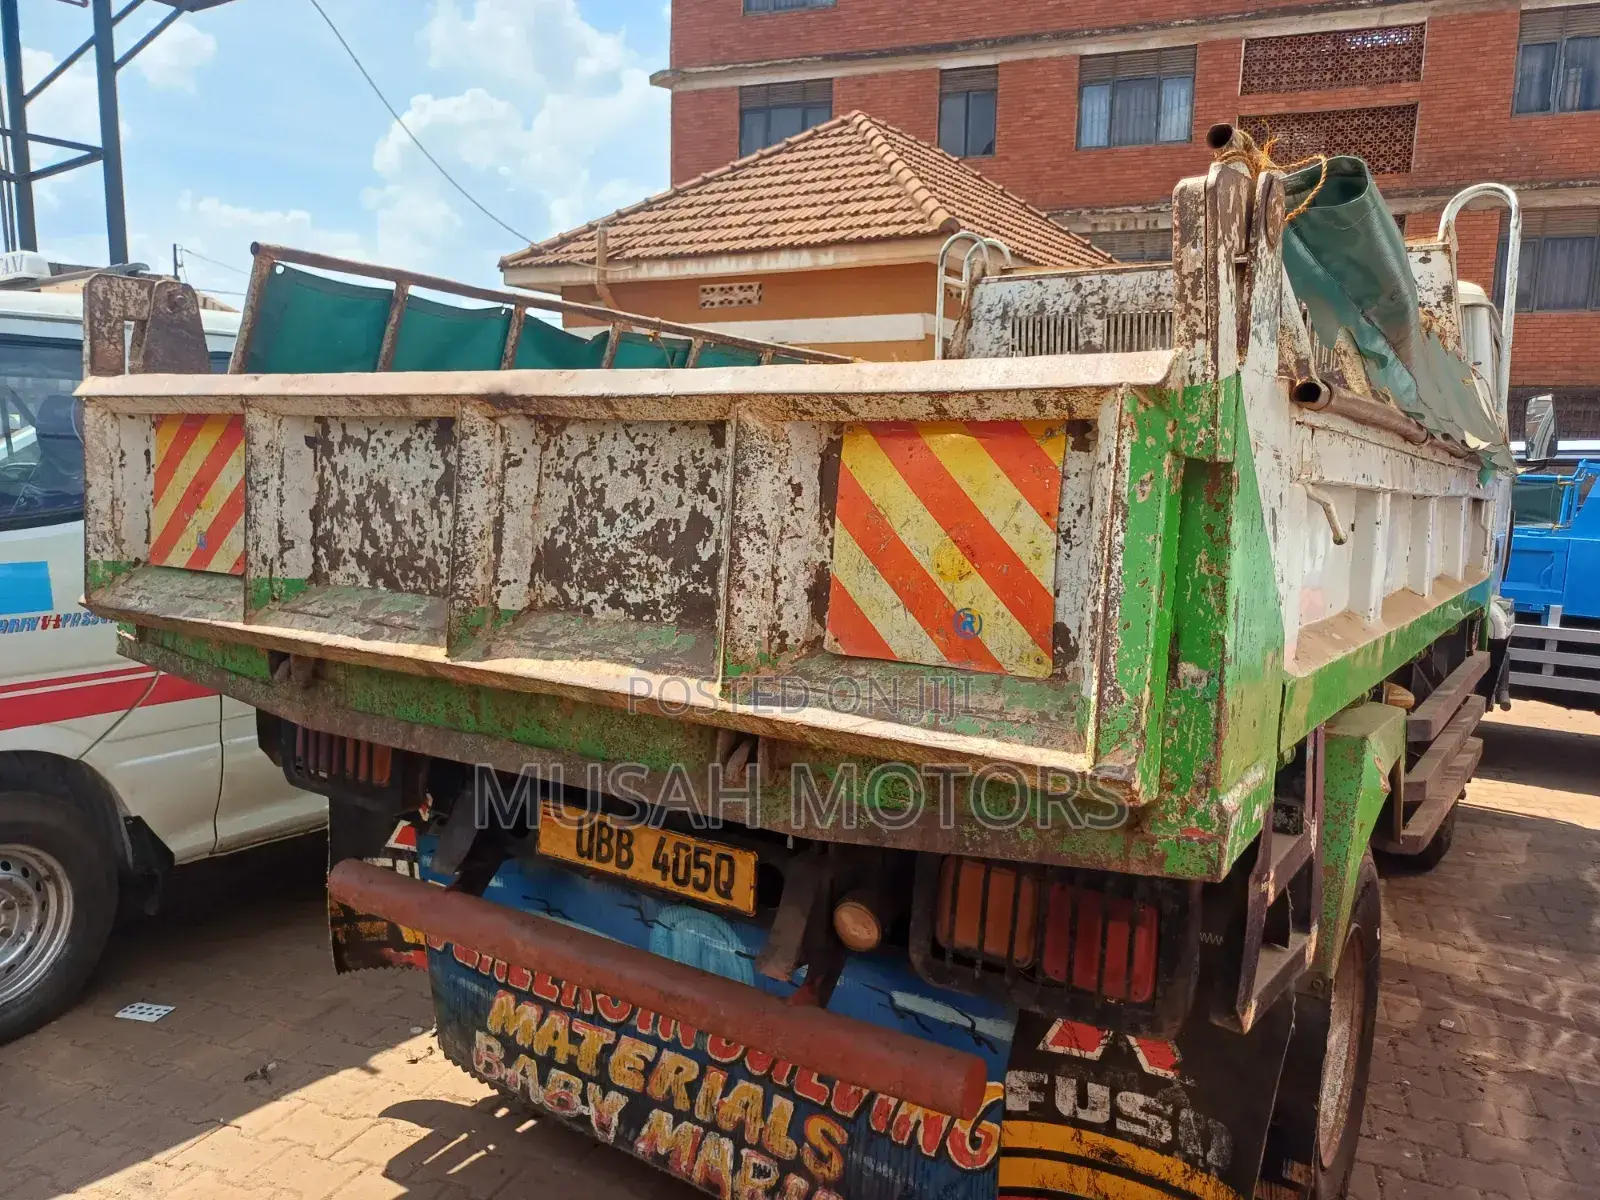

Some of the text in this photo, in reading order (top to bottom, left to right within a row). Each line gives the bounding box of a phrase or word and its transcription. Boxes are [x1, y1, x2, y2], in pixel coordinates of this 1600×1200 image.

[576, 815, 736, 901] UBB 405Q
[472, 1029, 628, 1143] BABY
[486, 989, 849, 1183] MATERIALS
